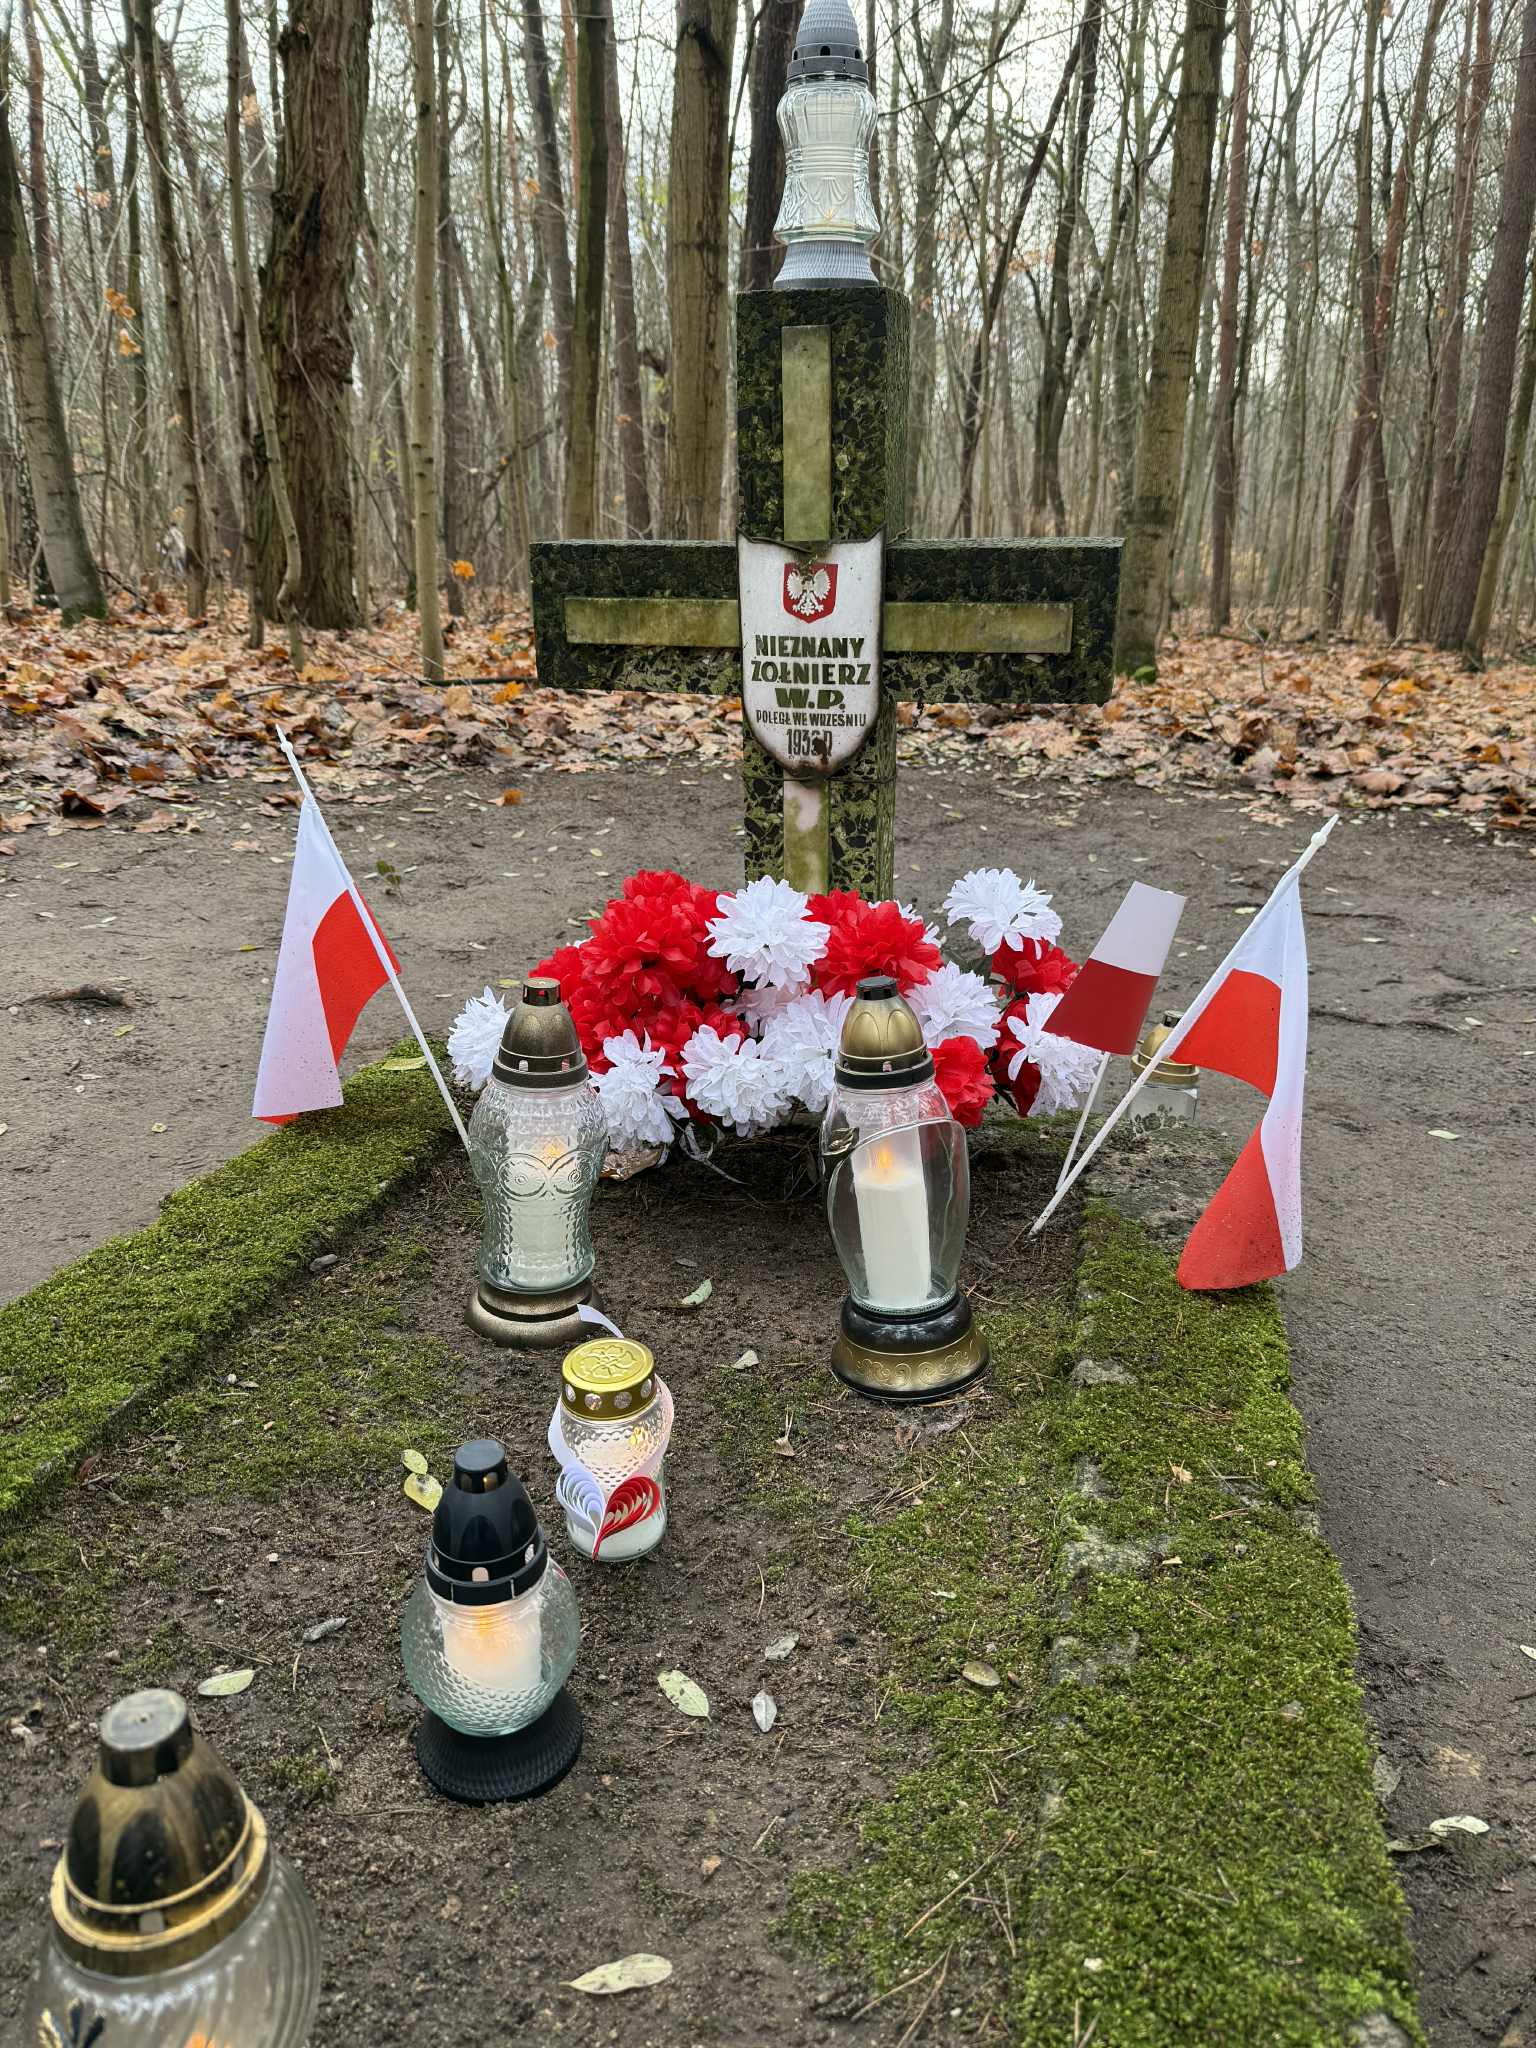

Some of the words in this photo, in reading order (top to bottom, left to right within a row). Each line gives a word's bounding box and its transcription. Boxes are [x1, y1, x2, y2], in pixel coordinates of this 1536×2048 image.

[755, 634, 865, 658] NIEZNANY
[775, 688, 846, 710] W.P.
[756, 710, 792, 726] POLEGŁ
[792, 712, 808, 726] WE
